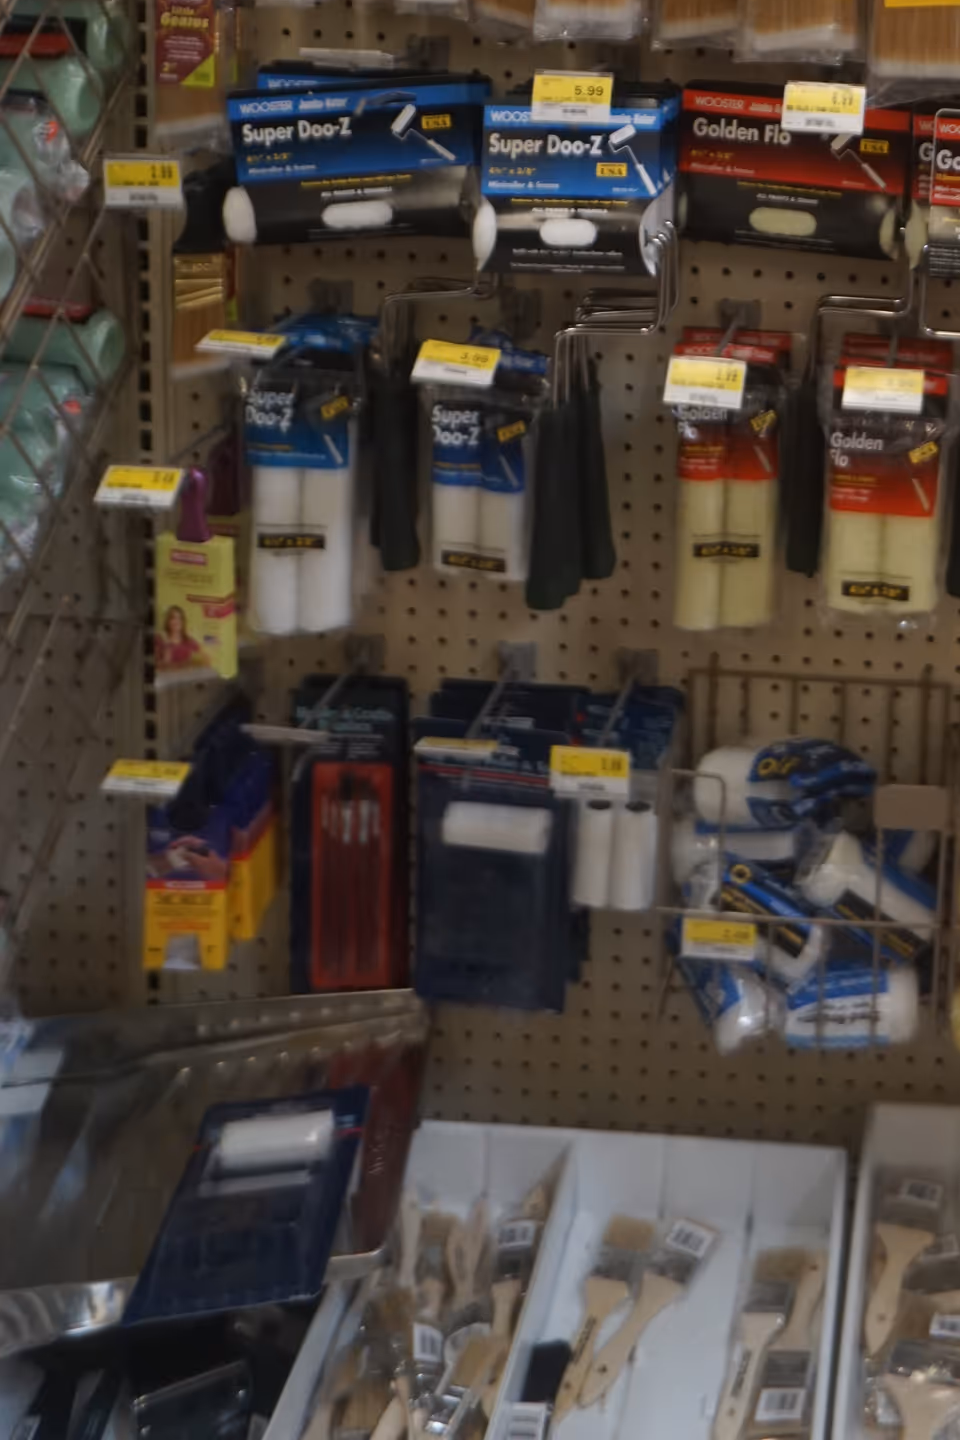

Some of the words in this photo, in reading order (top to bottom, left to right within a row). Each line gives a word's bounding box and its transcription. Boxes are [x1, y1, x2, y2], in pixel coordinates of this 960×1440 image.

[574, 85, 604, 97] 5.99
[694, 95, 745, 111] WOOSTER
[490, 109, 530, 122] WOOS
[242, 124, 294, 147] Super
[297, 116, 352, 139] Doo-Z
[693, 117, 759, 142] Golden
[763, 124, 792, 146] Flo
[488, 132, 544, 160] Super
[547, 134, 603, 155] Doo-Z
[247, 389, 295, 408] Super
[431, 404, 480, 426] Super
[829, 431, 884, 451] Golden
